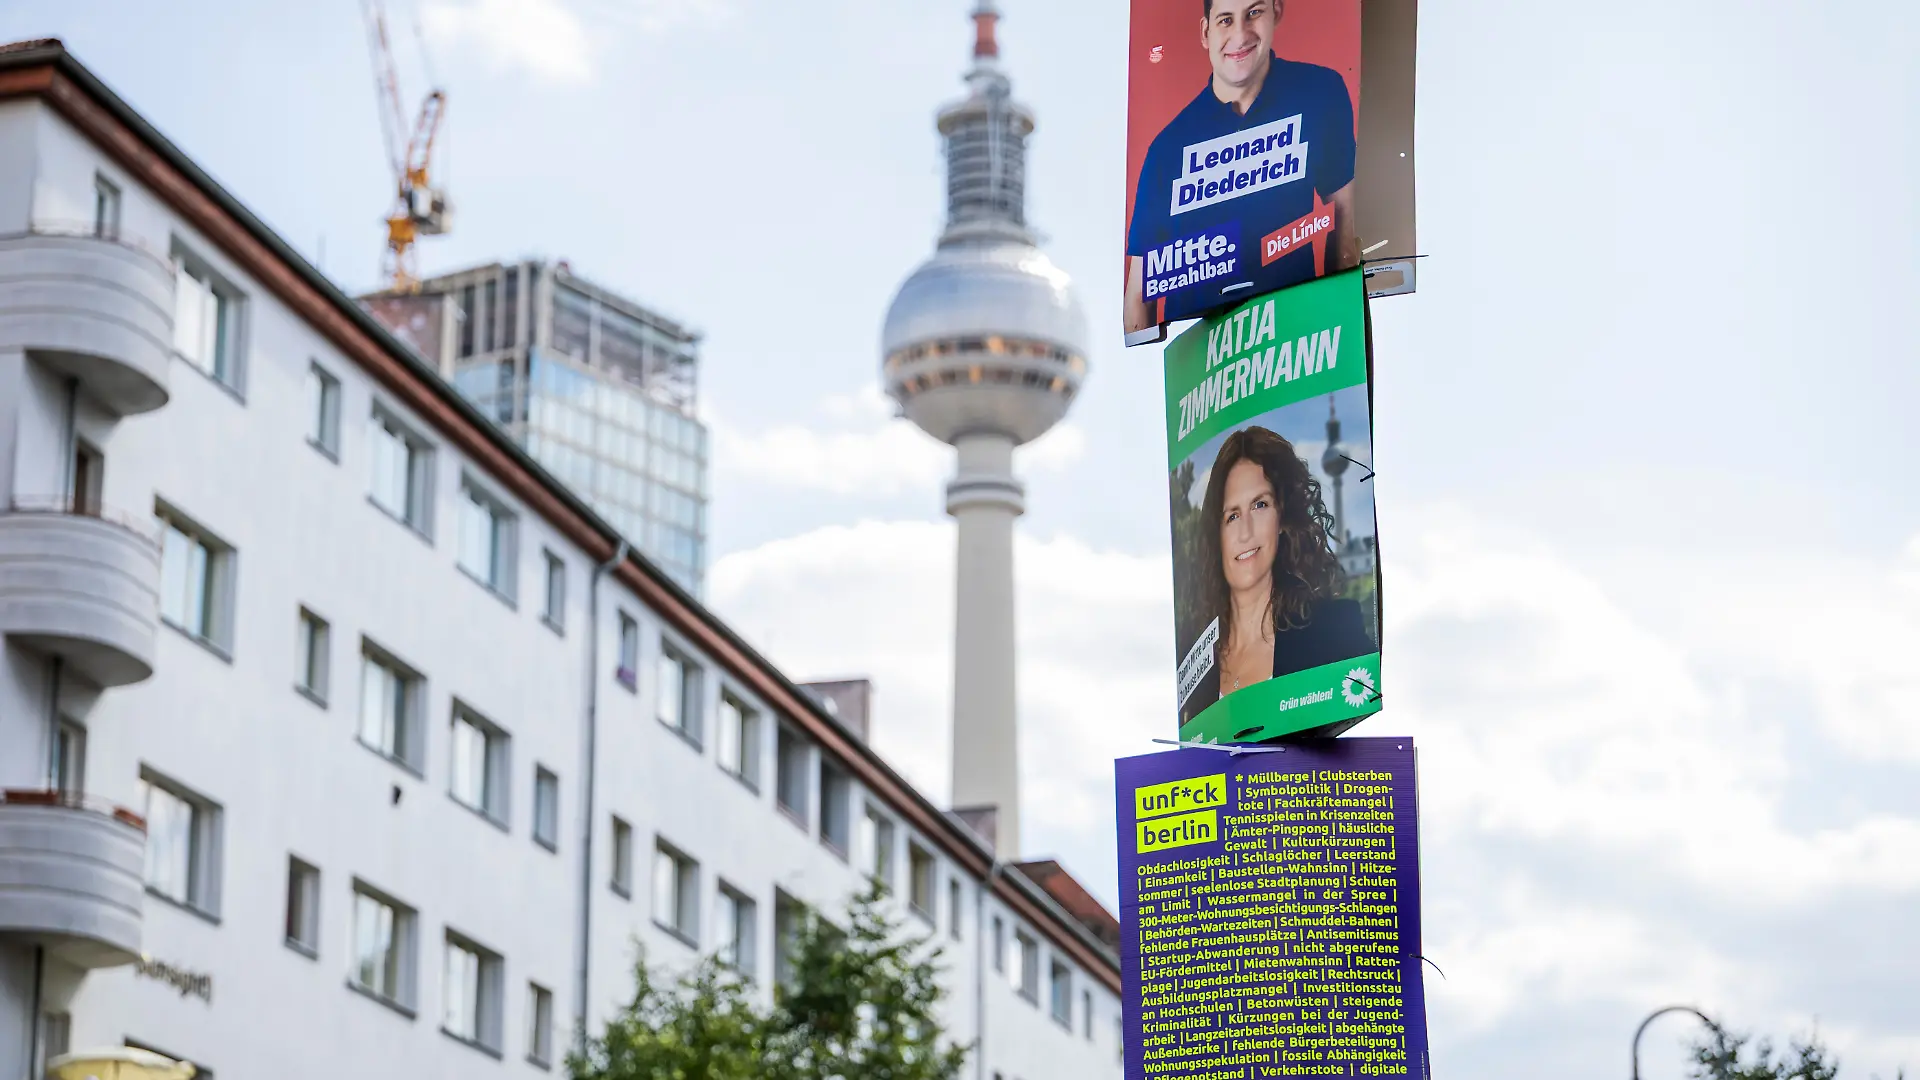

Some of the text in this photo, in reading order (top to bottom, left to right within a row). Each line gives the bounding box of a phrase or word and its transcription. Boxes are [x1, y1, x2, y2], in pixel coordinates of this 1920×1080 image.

[1189, 123, 1294, 174] Leonard
[1177, 153, 1299, 207] Diederich
[1266, 217, 1330, 258] Die Linke
[1146, 231, 1236, 278] Mitte.
[1146, 256, 1236, 298] Bezahlbar
[1205, 299, 1275, 372] KATJA
[1177, 325, 1342, 442] ZIMMERMANN
[1202, 627, 1217, 650] unser
[1279, 688, 1334, 712] Grün wählen!
[1248, 772, 1309, 784] Müllberge
[1319, 770, 1392, 781] Clubsterben
[1238, 800, 1264, 811] tote
[1274, 796, 1387, 809] Fachkräftemangel
[1245, 783, 1331, 799] Symbolpolitik
[1343, 783, 1393, 796] Drogen-
[1223, 809, 1394, 825] Tennisspielen in Krisenzeiten
[1231, 824, 1329, 838] Ämter-Pingpong
[1339, 822, 1395, 834] häusliche
[1143, 819, 1210, 846] berlin
[1224, 838, 1267, 852] Gewalt
[1282, 835, 1386, 849] Kulturkürzungen
[1137, 855, 1231, 876] Obdachlosigkeit
[1242, 849, 1322, 863] Schlaglöcher
[1334, 849, 1396, 860] Leerstand
[1145, 870, 1207, 888] Einsamkeit
[1218, 862, 1348, 879] Baustellen-Wahnsinn
[1360, 862, 1397, 873] Hitze-
[1138, 888, 1183, 902] sommer
[1191, 880, 1254, 895] seelenlose
[1257, 875, 1340, 889] Stadtplanung
[1349, 875, 1397, 887] Schulen
[1138, 905, 1155, 915] am
[1161, 899, 1191, 912] Limit
[1207, 889, 1297, 906] Wassermangel
[1303, 889, 1315, 899] in
[1322, 888, 1344, 900] der
[1351, 889, 1387, 902] Spree
[1139, 901, 1397, 928] 300-Meter-Wohnungsbesichtigungs-Schlangen
[1145, 918, 1272, 941] Behörden-Wartezeiten
[1280, 914, 1392, 927] Schmuddel-Bahnen
[1140, 939, 1189, 954] fehlende
[1191, 930, 1297, 948] Frauenhausplätze
[1306, 928, 1399, 940] Antisemitismus
[1148, 945, 1280, 967] Startup-Abwanderung
[1293, 941, 1325, 953] nicht
[1329, 942, 1399, 955] abgerufene
[1141, 959, 1232, 981] EU-Fördermittel
[1244, 955, 1343, 969] Mietenwahnsinn
[1355, 956, 1400, 967] Ratten-
[1141, 982, 1173, 996] plage
[1180, 968, 1318, 990] Jugendarbeitslosigkeit
[1328, 968, 1395, 980] Rechtsruck
[1141, 982, 1288, 1007] Ausbildungsplatzmangel
[1303, 981, 1402, 994] Investitionsstau
[1142, 1011, 1156, 1021] an
[1159, 1001, 1233, 1018] Hochschulen
[1247, 997, 1329, 1009] Betonwüsten
[1342, 995, 1403, 1009] steigende
[1143, 1016, 1212, 1033] Kriminalität
[1228, 1012, 1295, 1024] Kürzungen
[1301, 1008, 1321, 1020] bei
[1327, 1008, 1349, 1020] der
[1354, 1009, 1403, 1022] Jugend-
[1143, 1033, 1176, 1047] arbeit
[1185, 1022, 1327, 1042] Langzeitarbeitslosigkeit
[1335, 1022, 1405, 1035] abgehängte
[1143, 1042, 1220, 1060] Außenbezirke
[1232, 1037, 1285, 1051] fehlende
[1289, 1035, 1397, 1049] Bürgerbeteiligung
[1143, 1052, 1270, 1074] Wohnungsspekulation
[1282, 1049, 1323, 1061] fossile
[1327, 1049, 1406, 1062] Abhängigkeit
[1260, 1064, 1344, 1077] Verkehrstote
[1360, 1063, 1407, 1077] digitale
